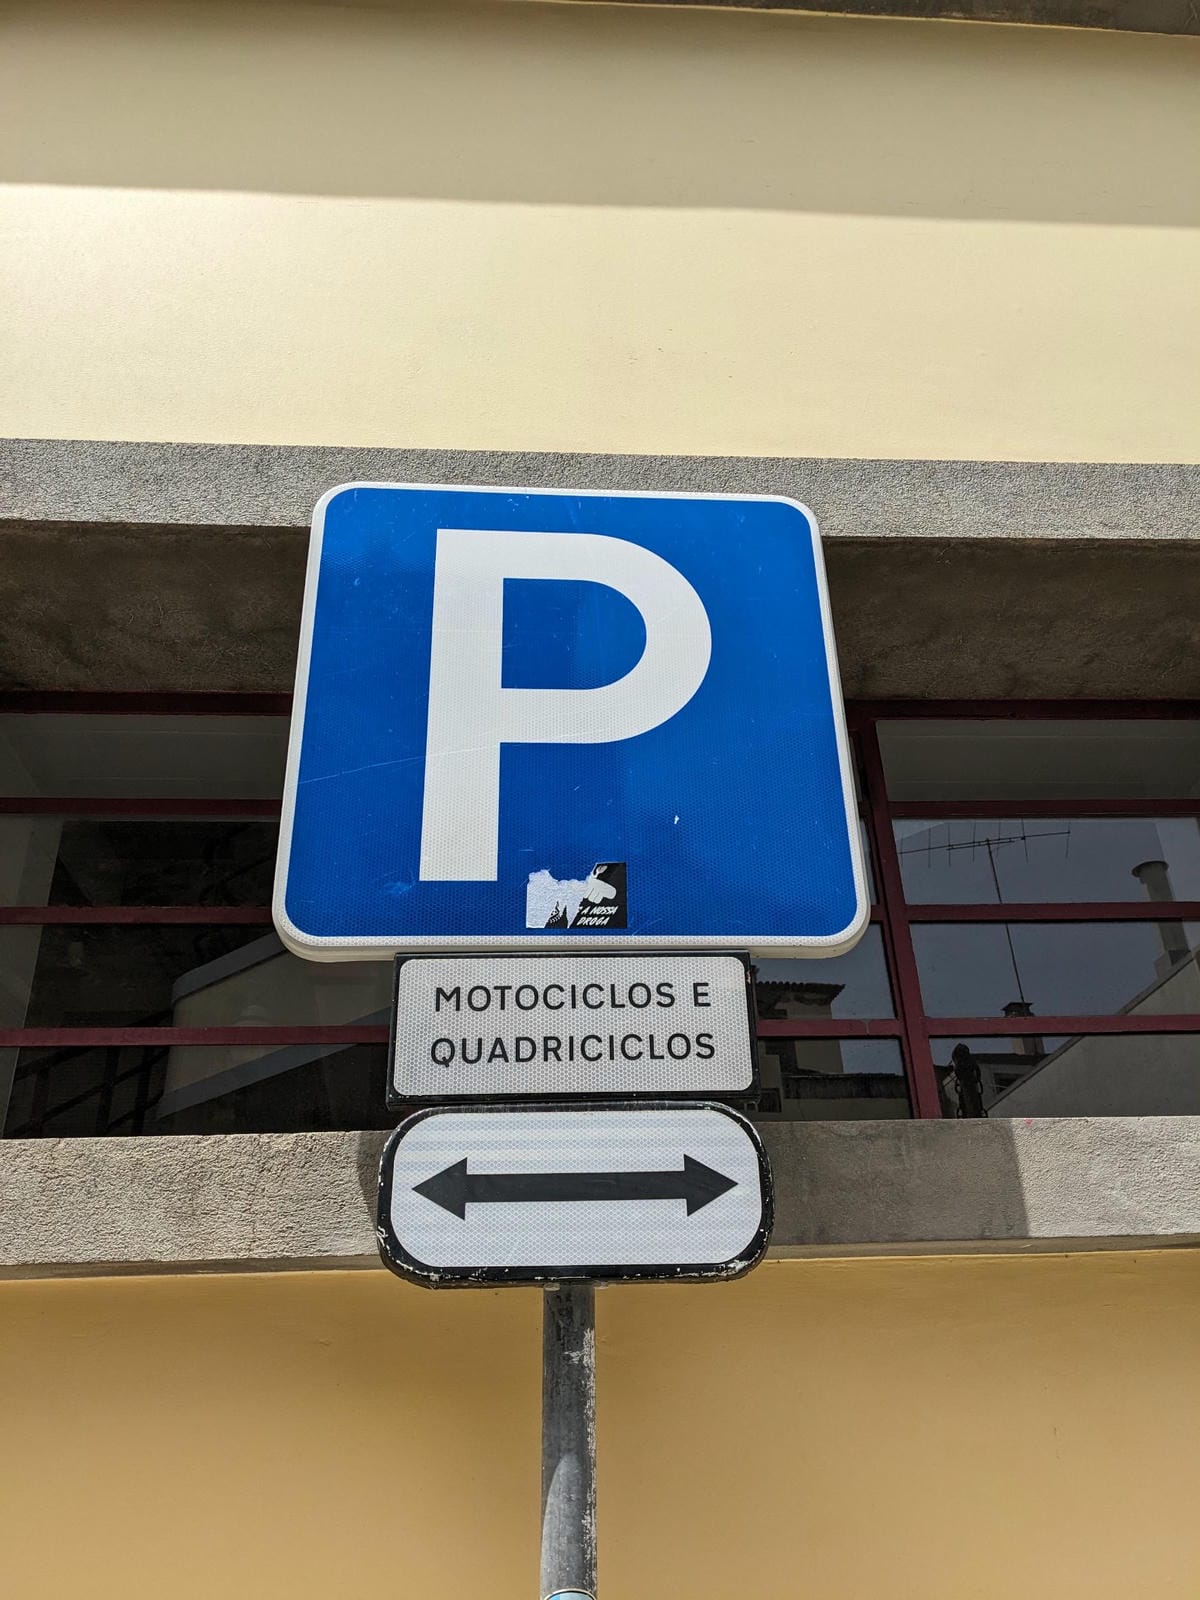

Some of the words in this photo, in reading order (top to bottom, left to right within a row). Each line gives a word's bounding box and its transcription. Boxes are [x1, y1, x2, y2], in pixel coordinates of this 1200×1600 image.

[419, 528, 712, 882] P
[577, 916, 609, 926] DROGA
[590, 906, 618, 915] NOSSA
[435, 982, 676, 1012] MOTOCICLOS
[693, 982, 711, 1007] E
[431, 1033, 716, 1067] QUADRICICLOS
